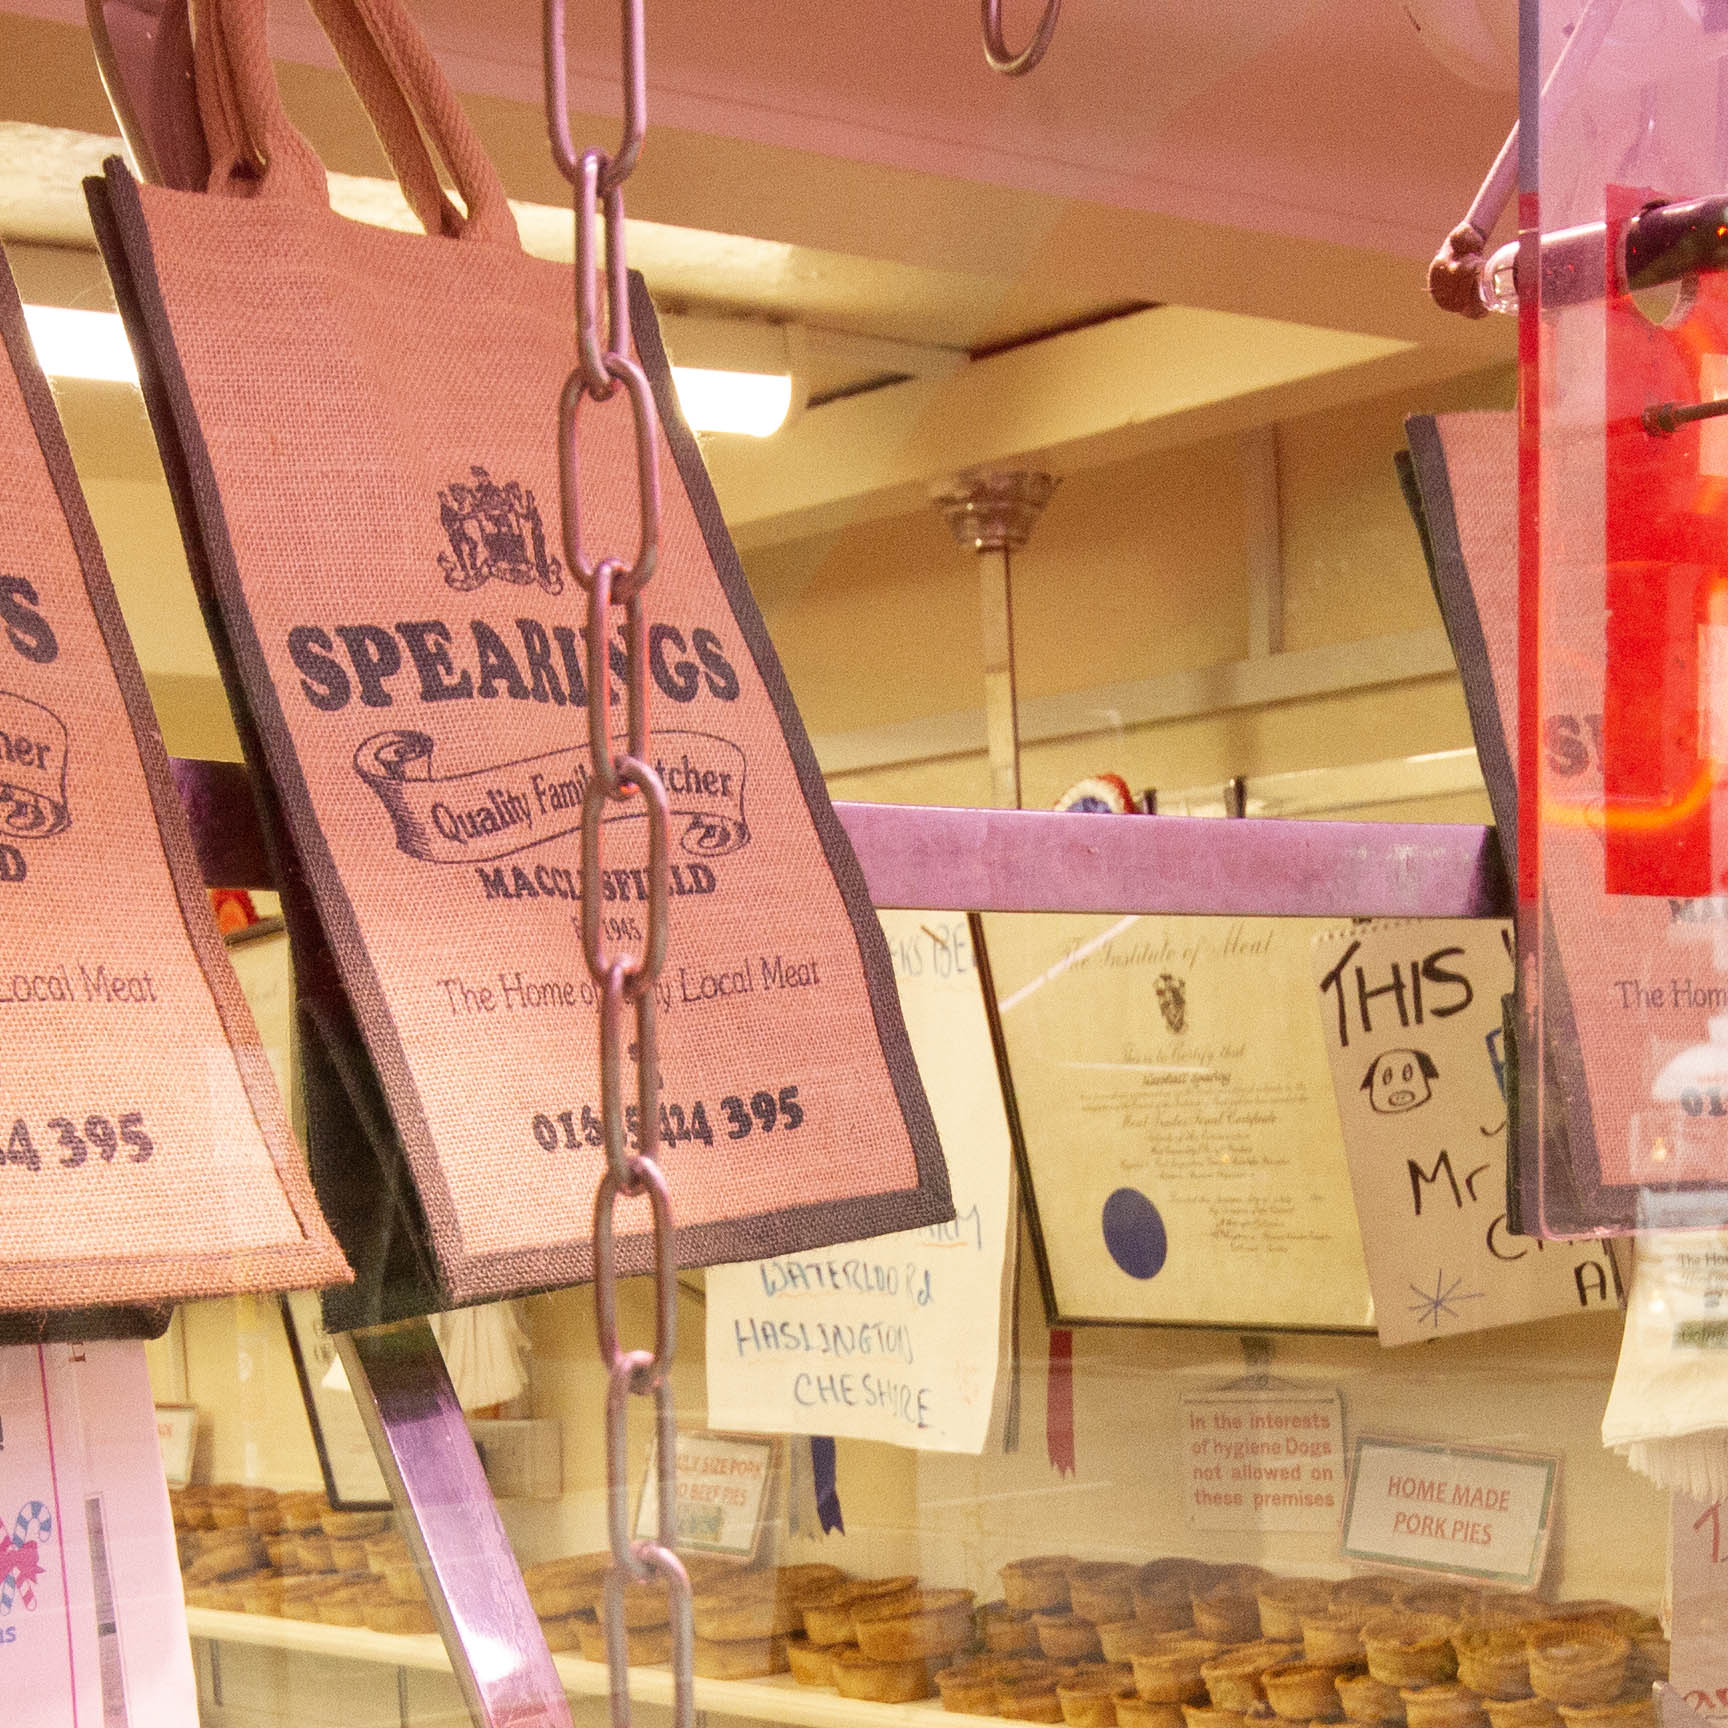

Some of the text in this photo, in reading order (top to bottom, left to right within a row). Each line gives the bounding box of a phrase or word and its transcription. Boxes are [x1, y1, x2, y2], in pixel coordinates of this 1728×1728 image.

[431, 790, 533, 845] Quality
[605, 917, 642, 941] 1945
[81, 964, 156, 1001] Meat
[438, 977, 494, 1017] The
[501, 972, 578, 1011] Home
[679, 958, 754, 1002] Local
[761, 956, 821, 990] Meat
[1320, 940, 1475, 1048] THIS
[1615, 980, 1664, 1010] The
[659, 1086, 805, 1148] 424 395
[47, 1111, 153, 1169] 395
[1406, 1150, 1492, 1216] Mr
[733, 1316, 917, 1363] HASLINGTON
[1213, 1412, 1243, 1431] the
[1249, 1412, 1331, 1431] interests
[1191, 1436, 1333, 1459] of hygiene Dogs
[1192, 1462, 1334, 1482] not allowed on
[1193, 1488, 1336, 1512] these premises
[1388, 1475, 1512, 1513] HOME MADE
[1392, 1511, 1493, 1547] PORK PIES
